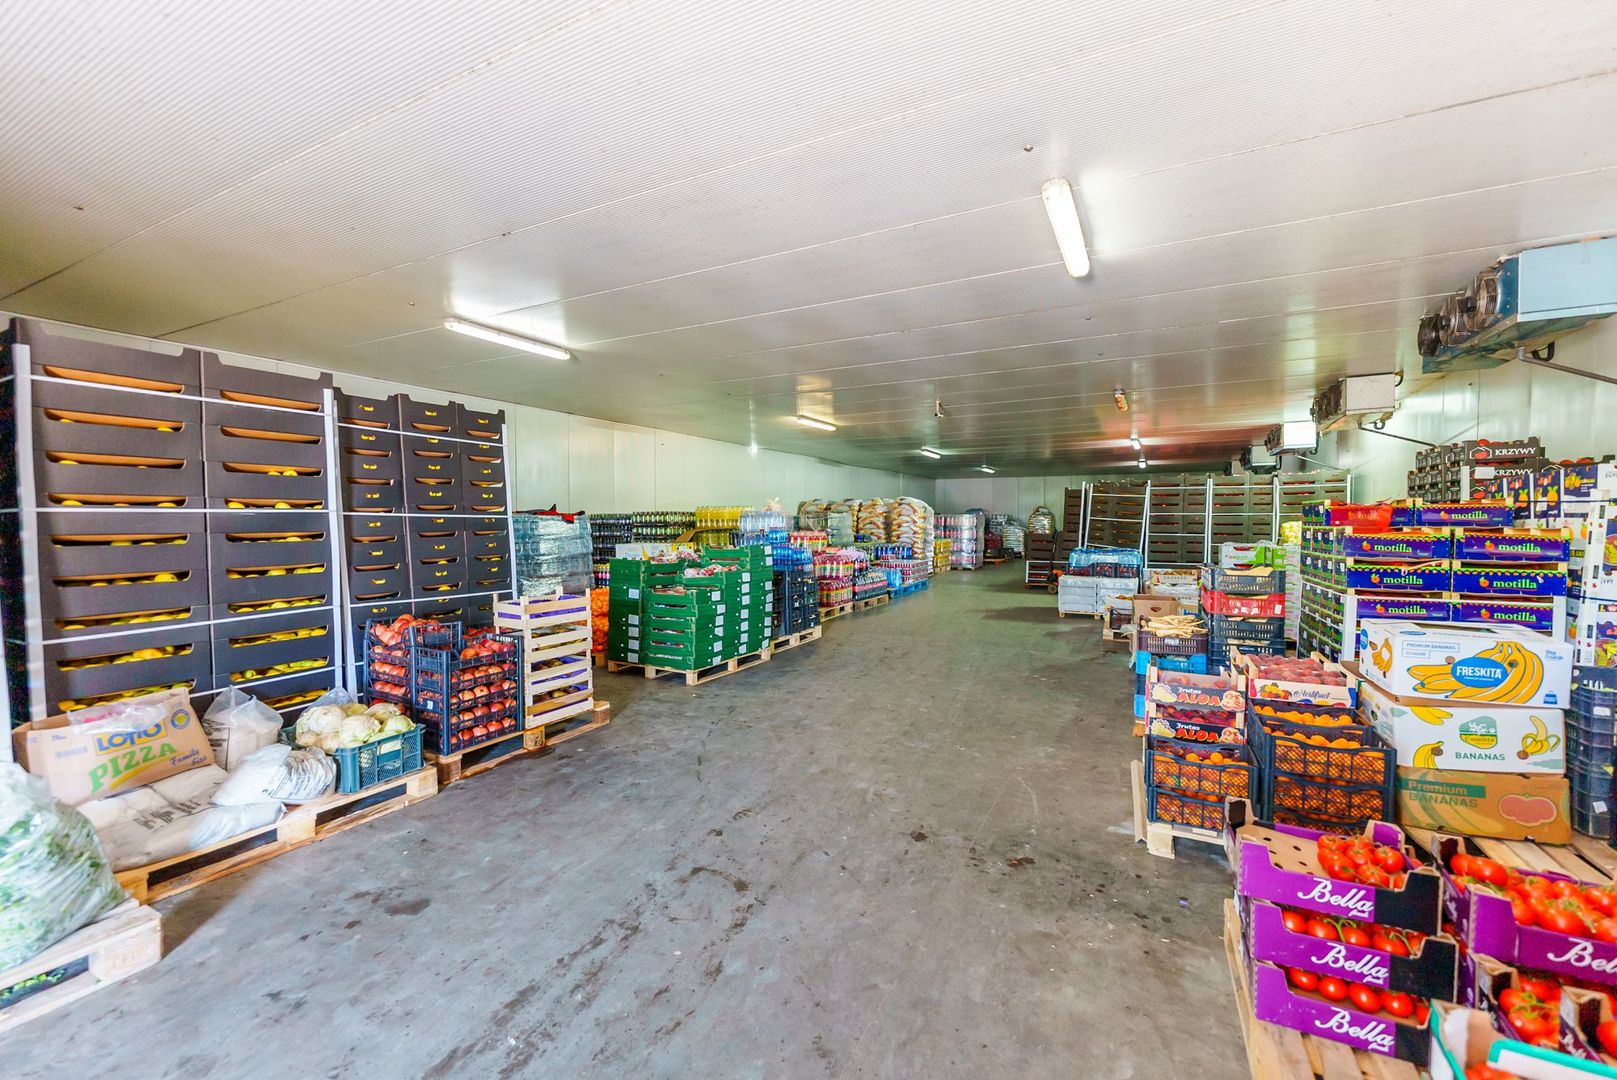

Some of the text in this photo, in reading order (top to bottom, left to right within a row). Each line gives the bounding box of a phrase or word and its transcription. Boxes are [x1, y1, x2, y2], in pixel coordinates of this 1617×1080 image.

[1495, 447, 1536, 456] KRZYWY
[1451, 510, 1488, 519] motilla
[1374, 543, 1412, 553] motilla
[1498, 542, 1541, 553] motilla
[1383, 575, 1423, 585] motilla
[1493, 578, 1537, 589] motilla
[1388, 605, 1427, 615] motilla
[1494, 611, 1537, 622] motilla
[1456, 665, 1503, 679] FRESKITA
[1455, 751, 1506, 761] BANANAS
[88, 742, 178, 796] PIZZA
[1408, 781, 1468, 796] Premium
[1408, 792, 1478, 809] BANANAS
[1297, 877, 1375, 912] Bella
[1310, 942, 1389, 978] Bella
[1314, 1006, 1395, 1046] Bella
